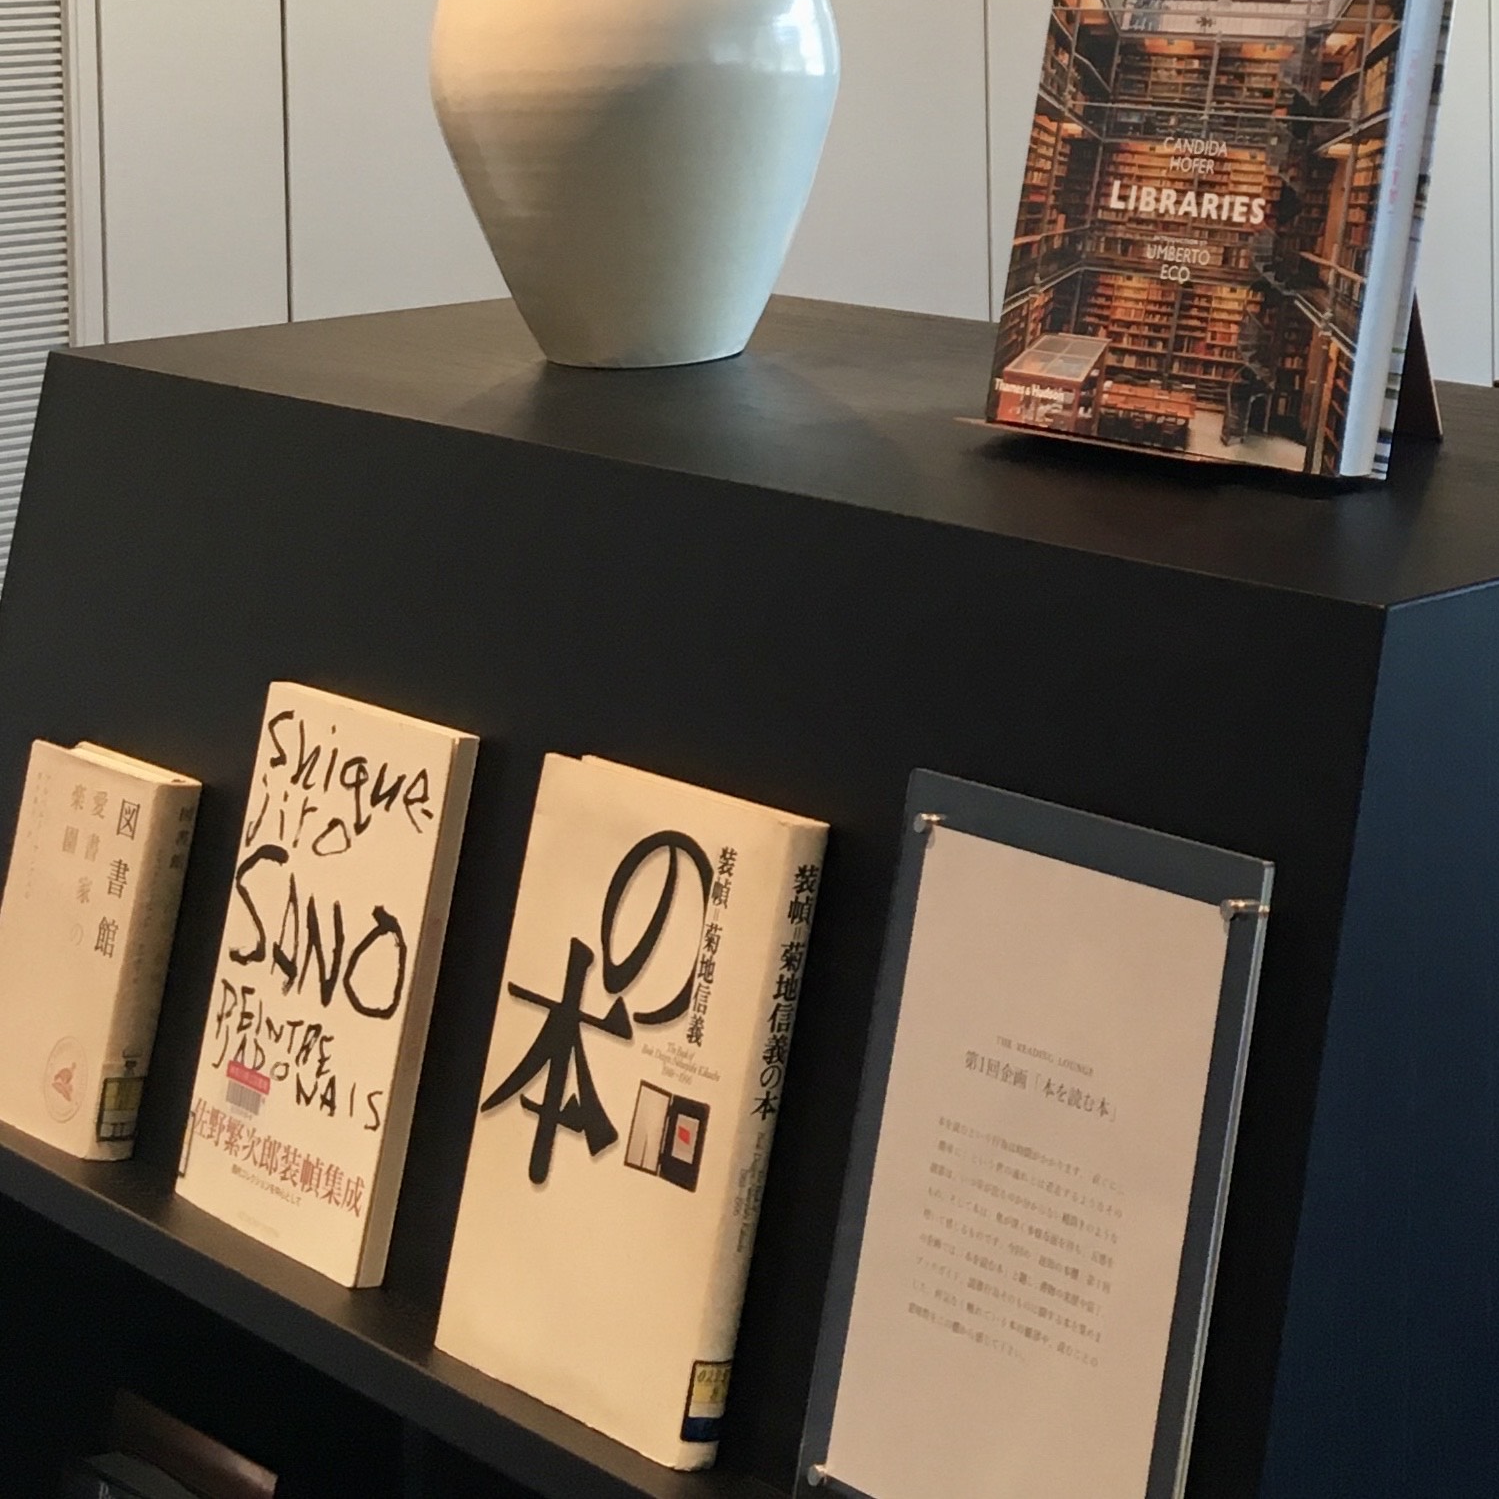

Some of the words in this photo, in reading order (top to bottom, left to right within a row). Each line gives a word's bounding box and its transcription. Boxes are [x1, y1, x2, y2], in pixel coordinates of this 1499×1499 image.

[1163, 136, 1229, 157] CANDIDA
[1110, 180, 1266, 225] LIBRARIES
[1146, 244, 1211, 266] UMBERTO
[1159, 264, 1191, 284] ECO
[94, 798, 141, 959] 図書館
[228, 843, 408, 1021] SANO
[193, 1097, 366, 1219] 佐野繁次郎装幀集成
